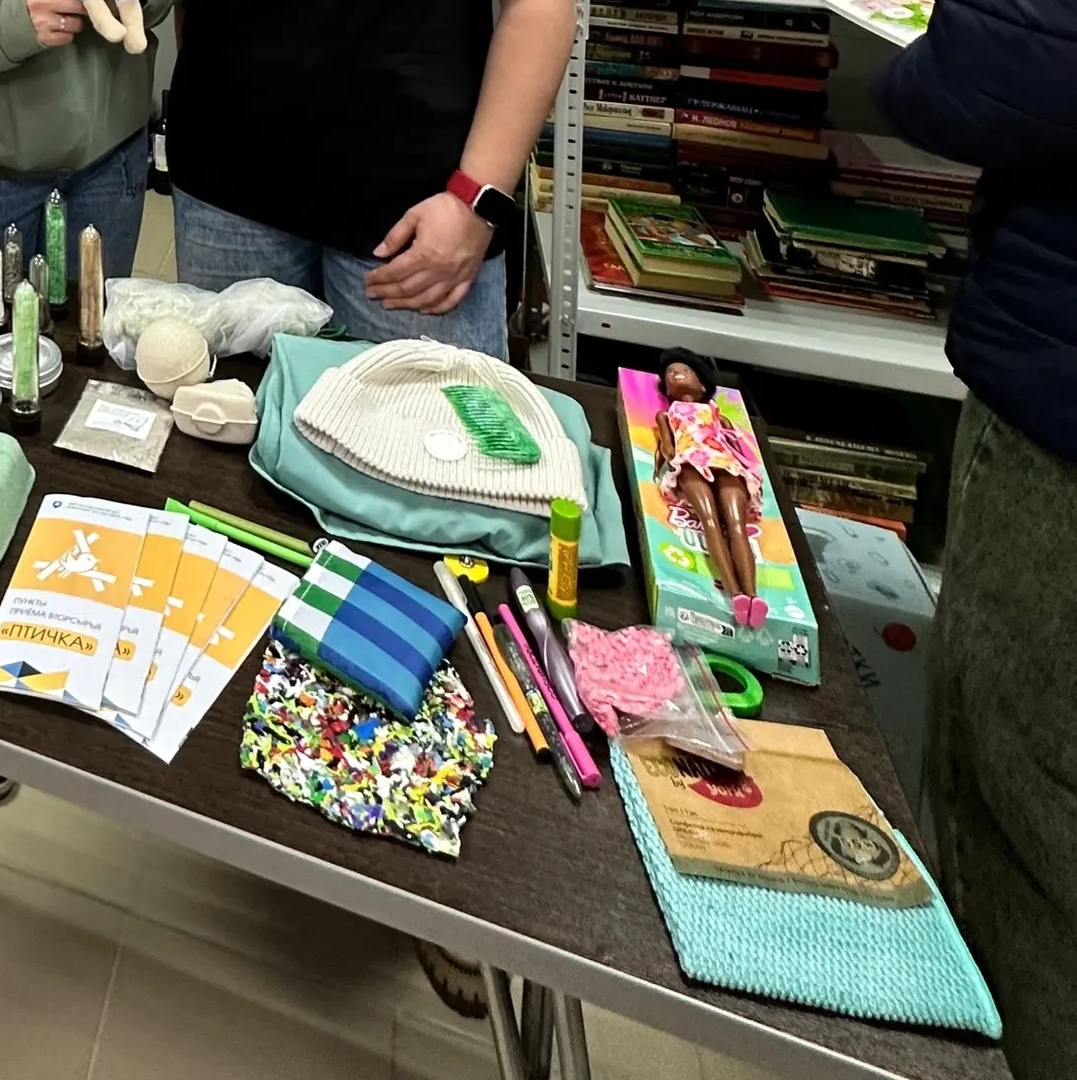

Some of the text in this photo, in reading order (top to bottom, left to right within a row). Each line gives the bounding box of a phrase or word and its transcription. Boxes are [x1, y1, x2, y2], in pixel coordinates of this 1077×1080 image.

[12, 596, 48, 608] ПУНКТЫ
[9, 605, 47, 620] ПРИЁМА
[48, 611, 102, 631] ВТОРСЫРЬЯ
[0, 623, 94, 652] «ПТИЧКА»
